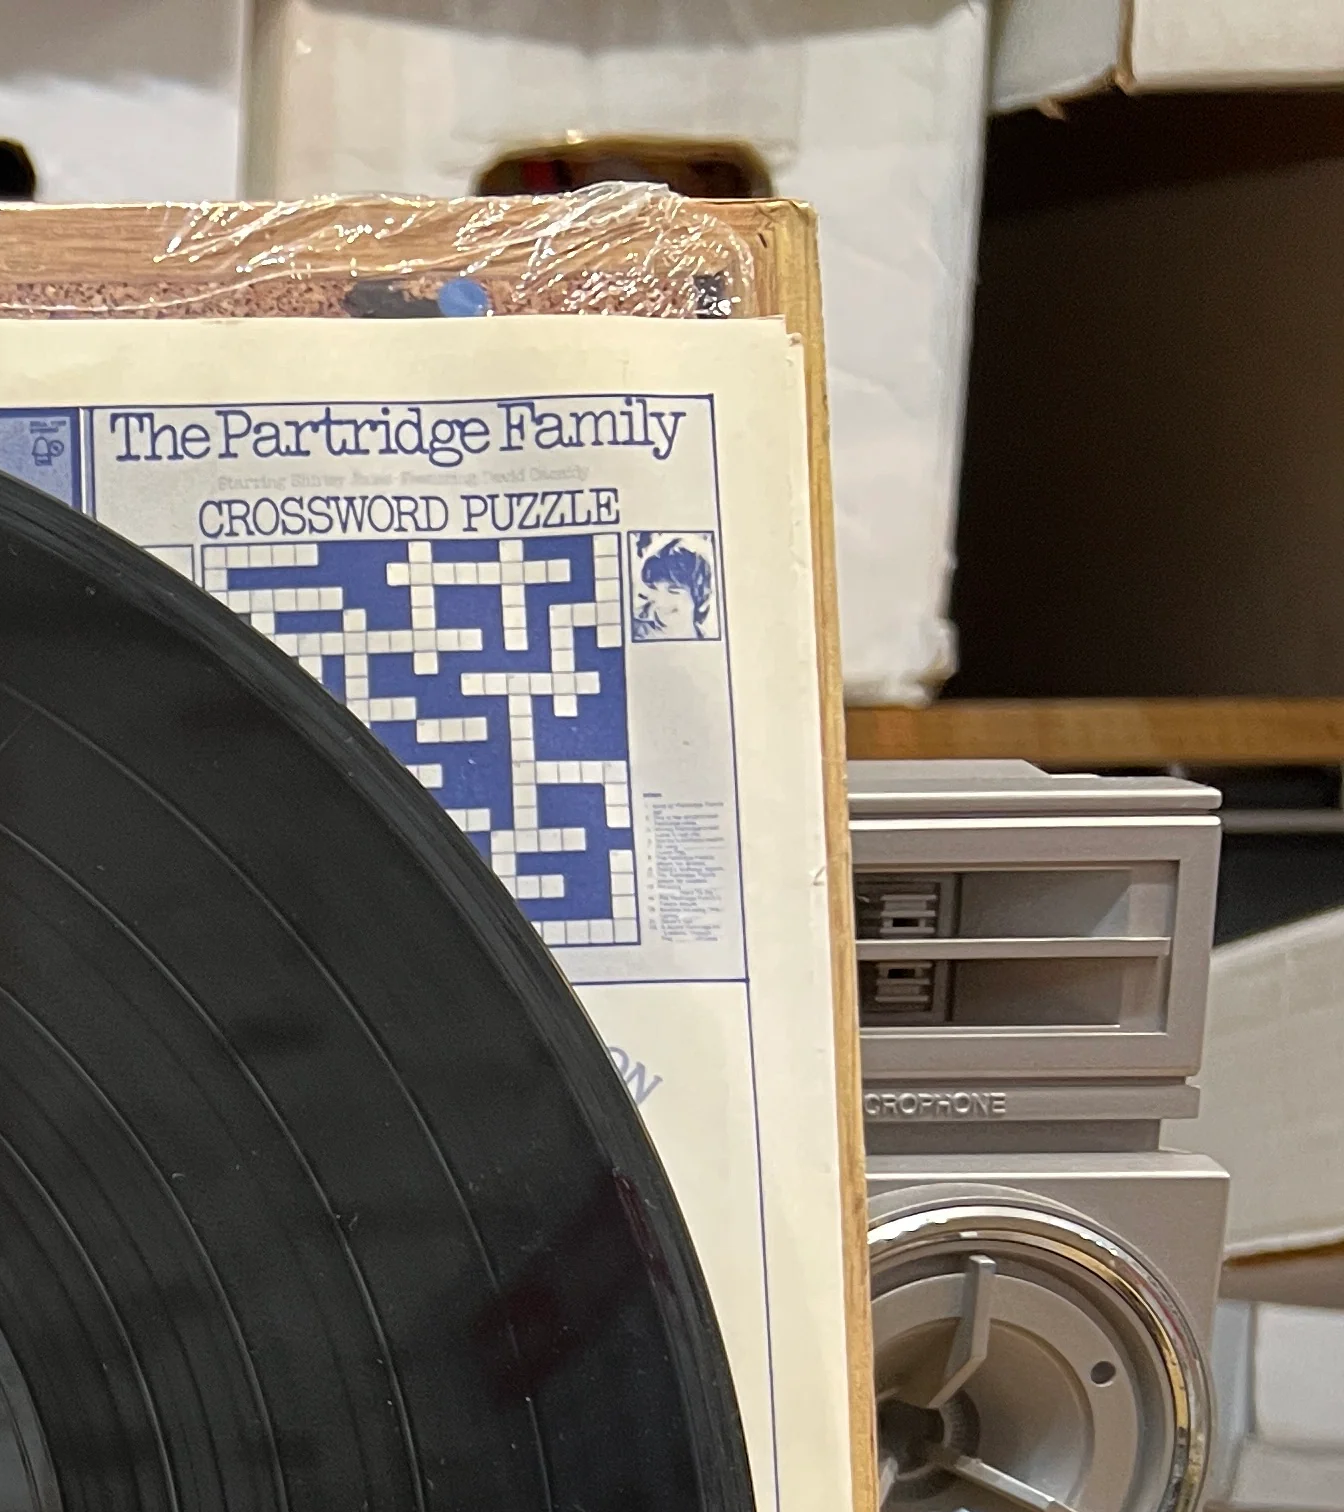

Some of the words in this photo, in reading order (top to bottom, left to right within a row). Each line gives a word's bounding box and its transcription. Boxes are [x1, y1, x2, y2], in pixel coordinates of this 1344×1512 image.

[110, 412, 211, 462] The
[215, 405, 490, 467] Partridge
[497, 396, 687, 461] Family
[198, 494, 449, 539] CROSSWORD
[460, 488, 621, 532] PUZZLE
[864, 1091, 1007, 1117] CROPHONE
